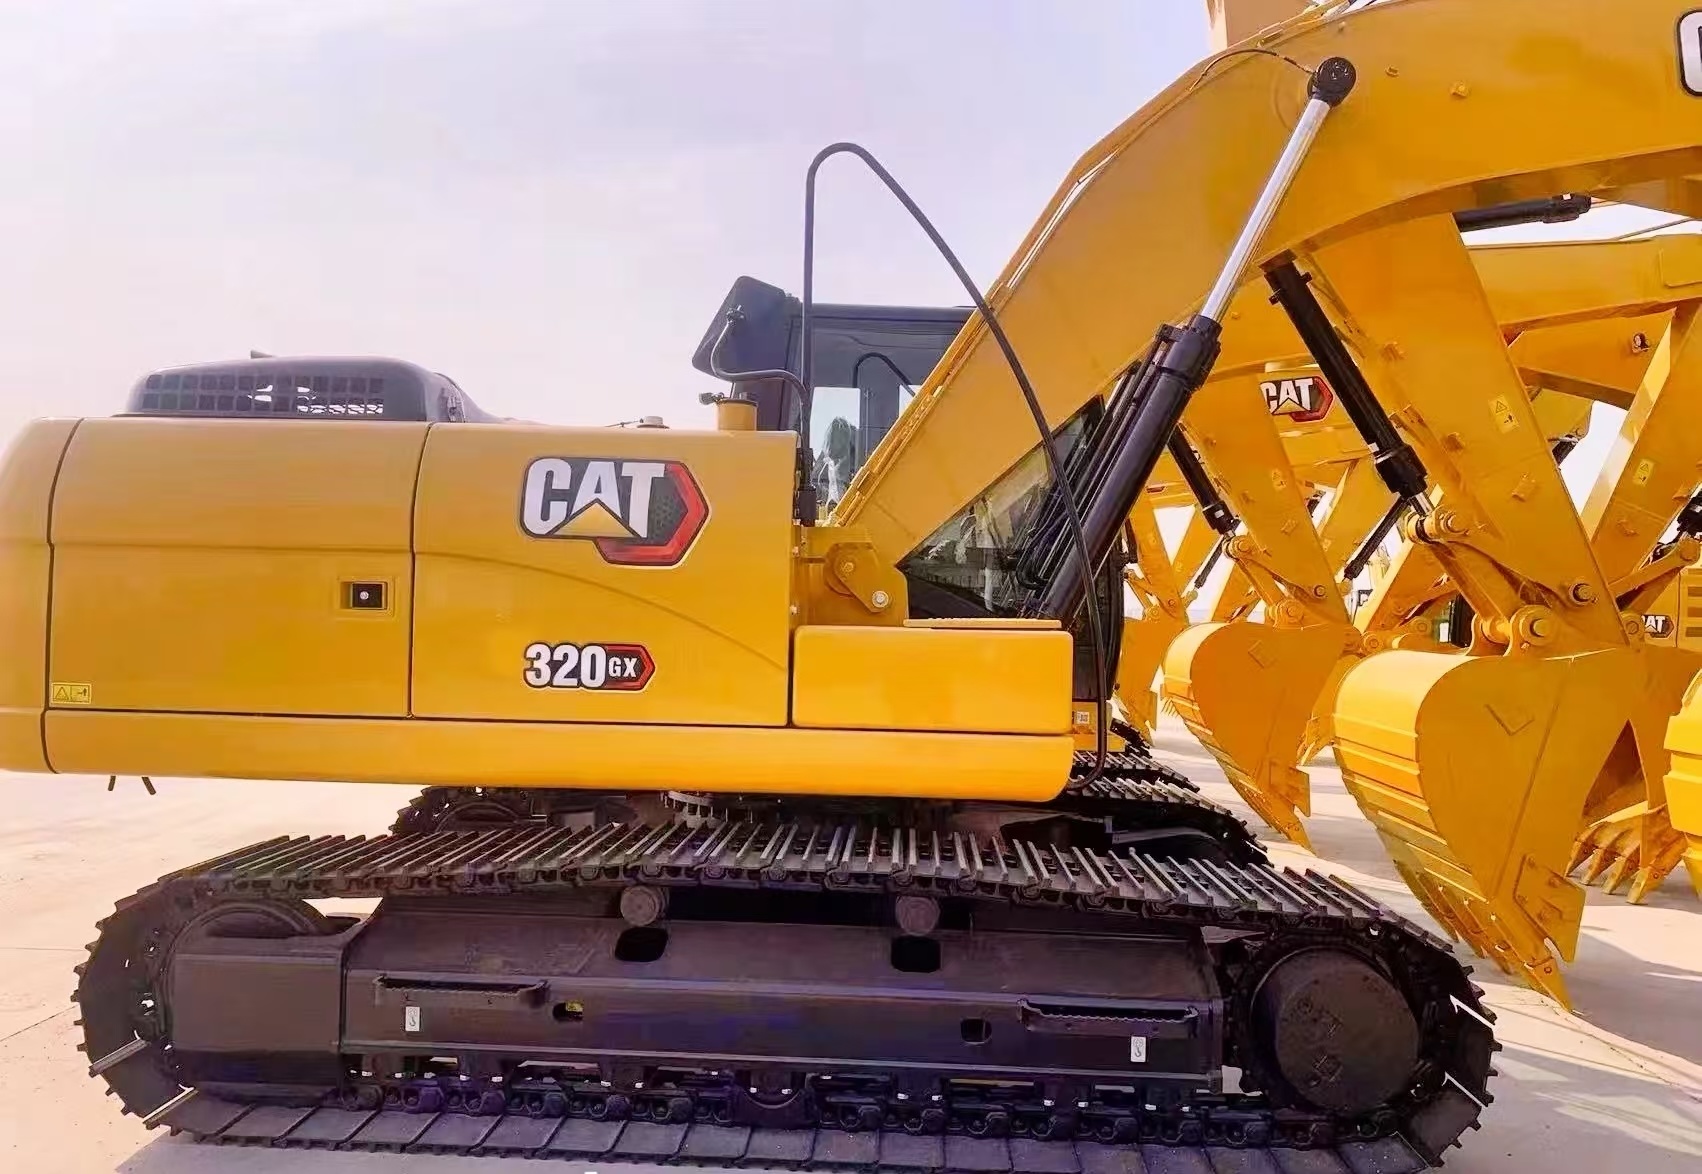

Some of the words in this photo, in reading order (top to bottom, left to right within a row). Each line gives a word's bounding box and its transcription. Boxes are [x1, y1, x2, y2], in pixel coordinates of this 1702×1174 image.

[1260, 378, 1313, 414] CAT
[523, 458, 665, 538] CAT
[1641, 615, 1665, 633] AT
